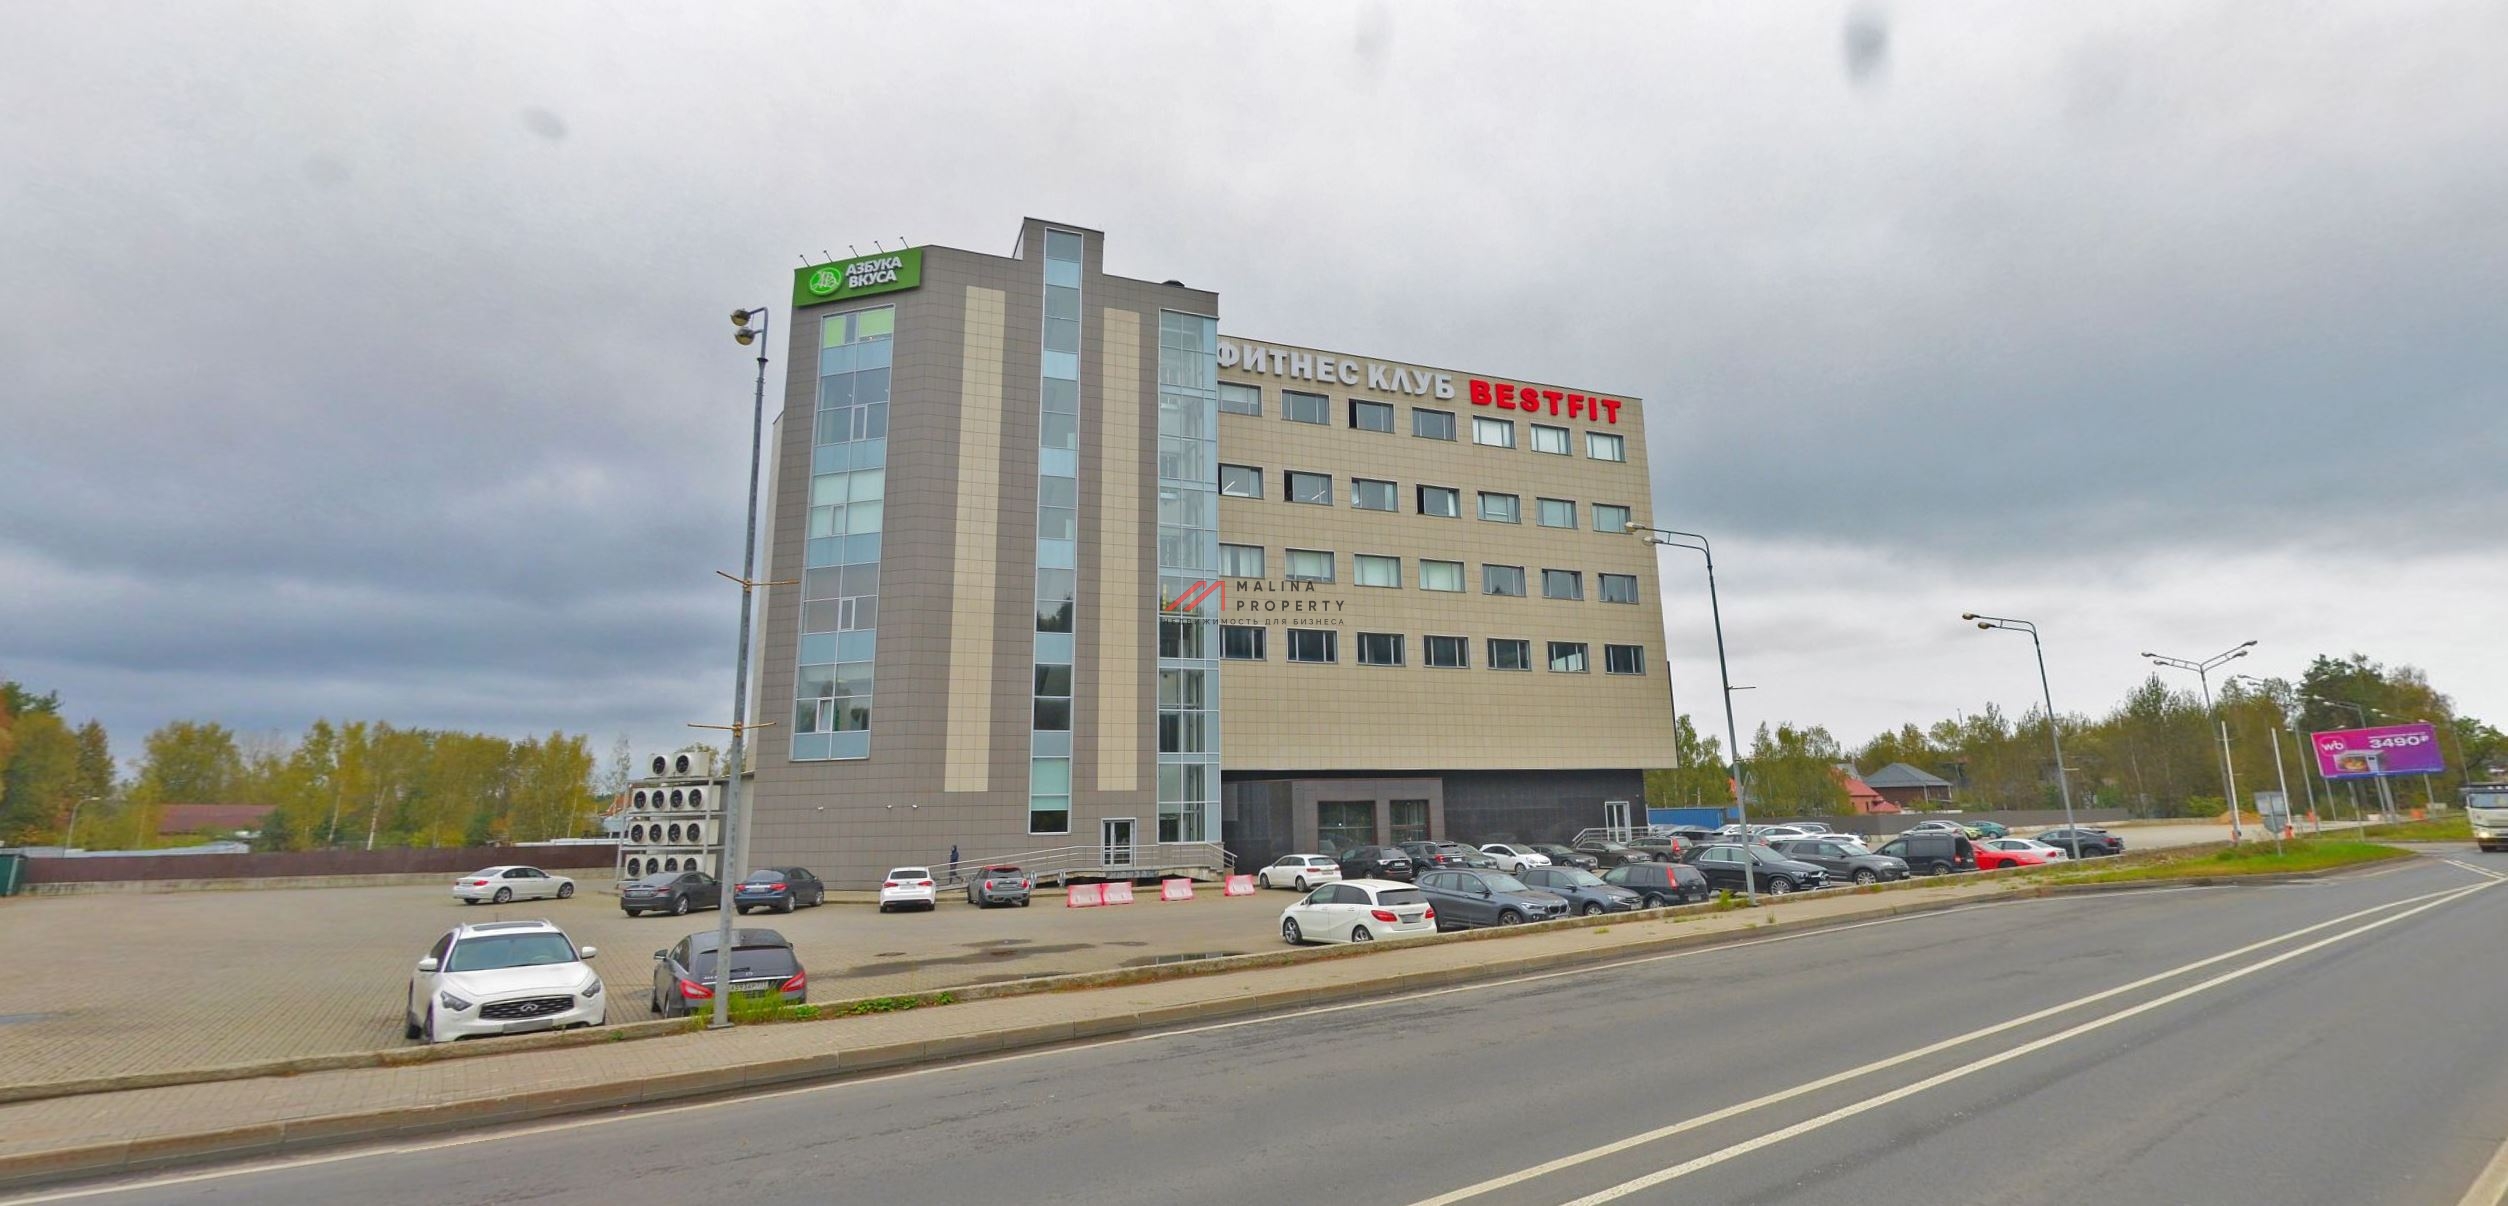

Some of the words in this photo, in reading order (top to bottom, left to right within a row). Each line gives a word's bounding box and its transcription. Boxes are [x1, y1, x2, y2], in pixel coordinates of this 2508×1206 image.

[845, 256, 902, 276] АЗБУКА
[848, 269, 898, 289] ВКУСА
[1216, 341, 1360, 386] ФИТНЕС
[1367, 363, 1456, 400] КЛУБ
[1469, 378, 1622, 424] BESTFIT
[2321, 740, 2344, 751] wb
